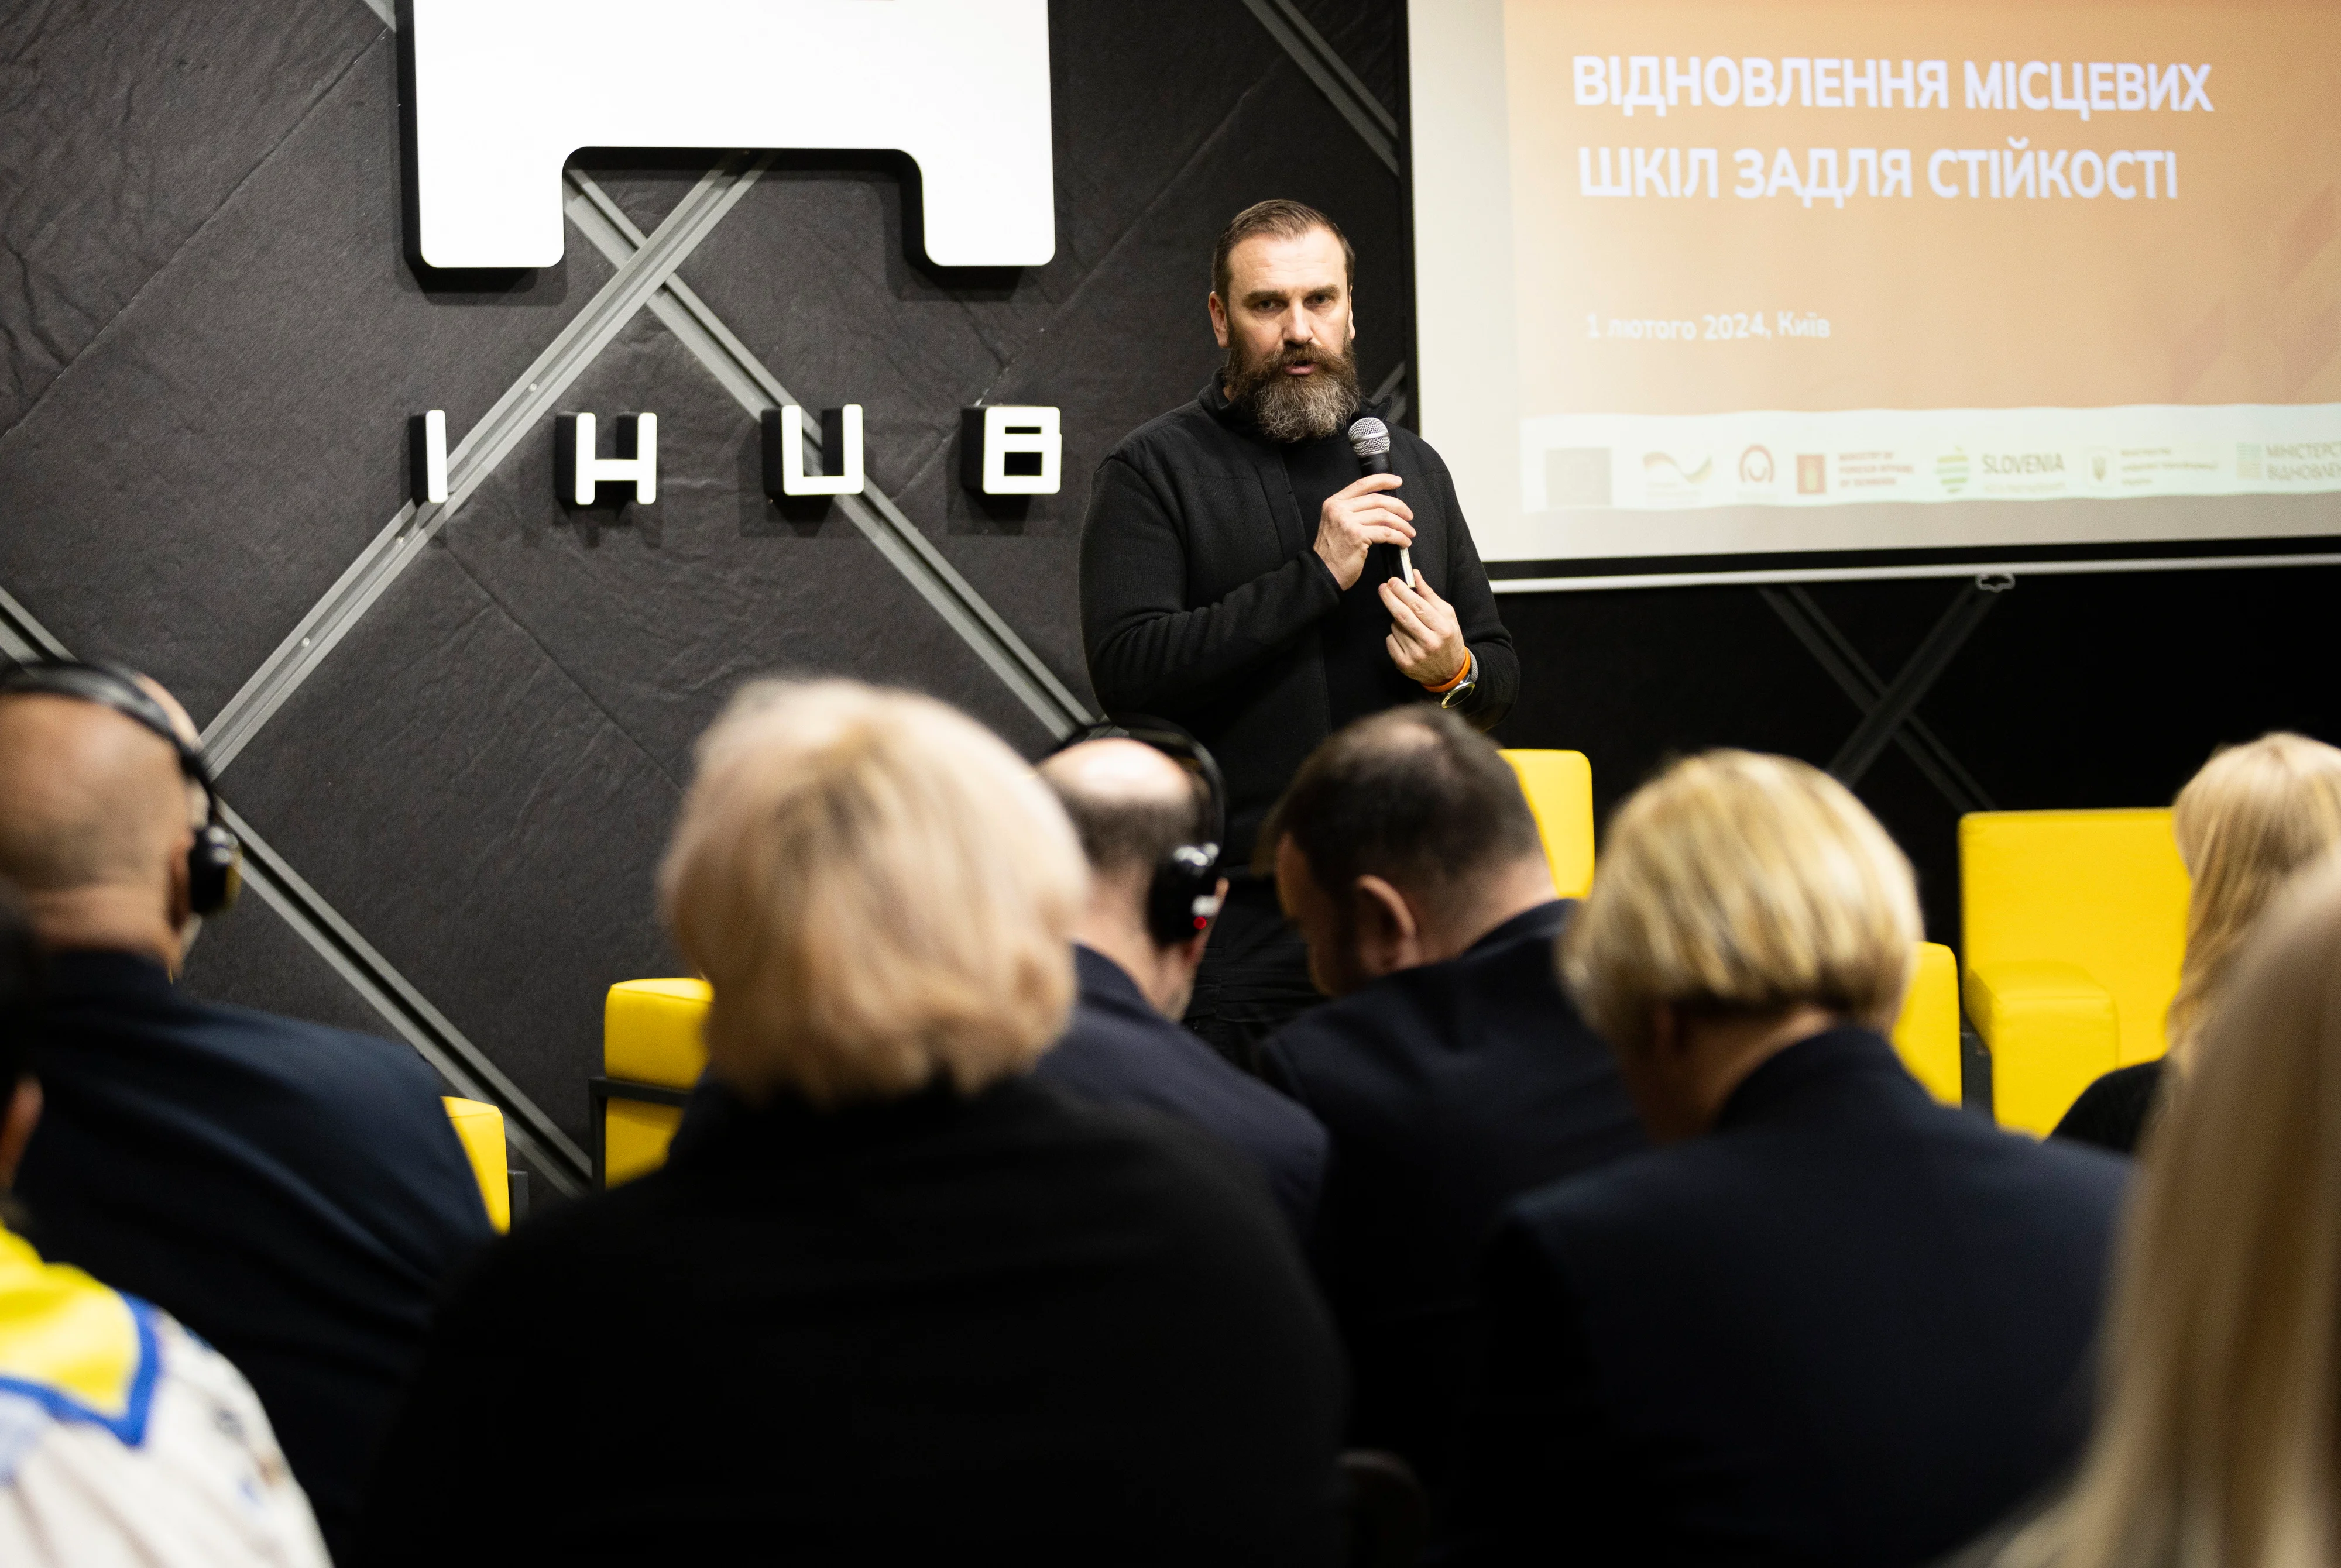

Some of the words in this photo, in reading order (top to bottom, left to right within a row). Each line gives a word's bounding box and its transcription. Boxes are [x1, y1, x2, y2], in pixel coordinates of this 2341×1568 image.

[1573, 56, 1949, 116] ВІДНОВЛЕННЯ
[1964, 60, 2215, 121] МІСЦЕВИХ
[1578, 147, 1719, 198] ШКІЛ
[1733, 147, 1913, 209] ЗАДЛЯ
[1927, 136, 2178, 200] СТІЙКОСТІ
[1587, 312, 1601, 339] 1
[1607, 318, 1697, 340] лютого
[1702, 312, 1772, 340] 2024,
[1777, 310, 1831, 338] Київ
